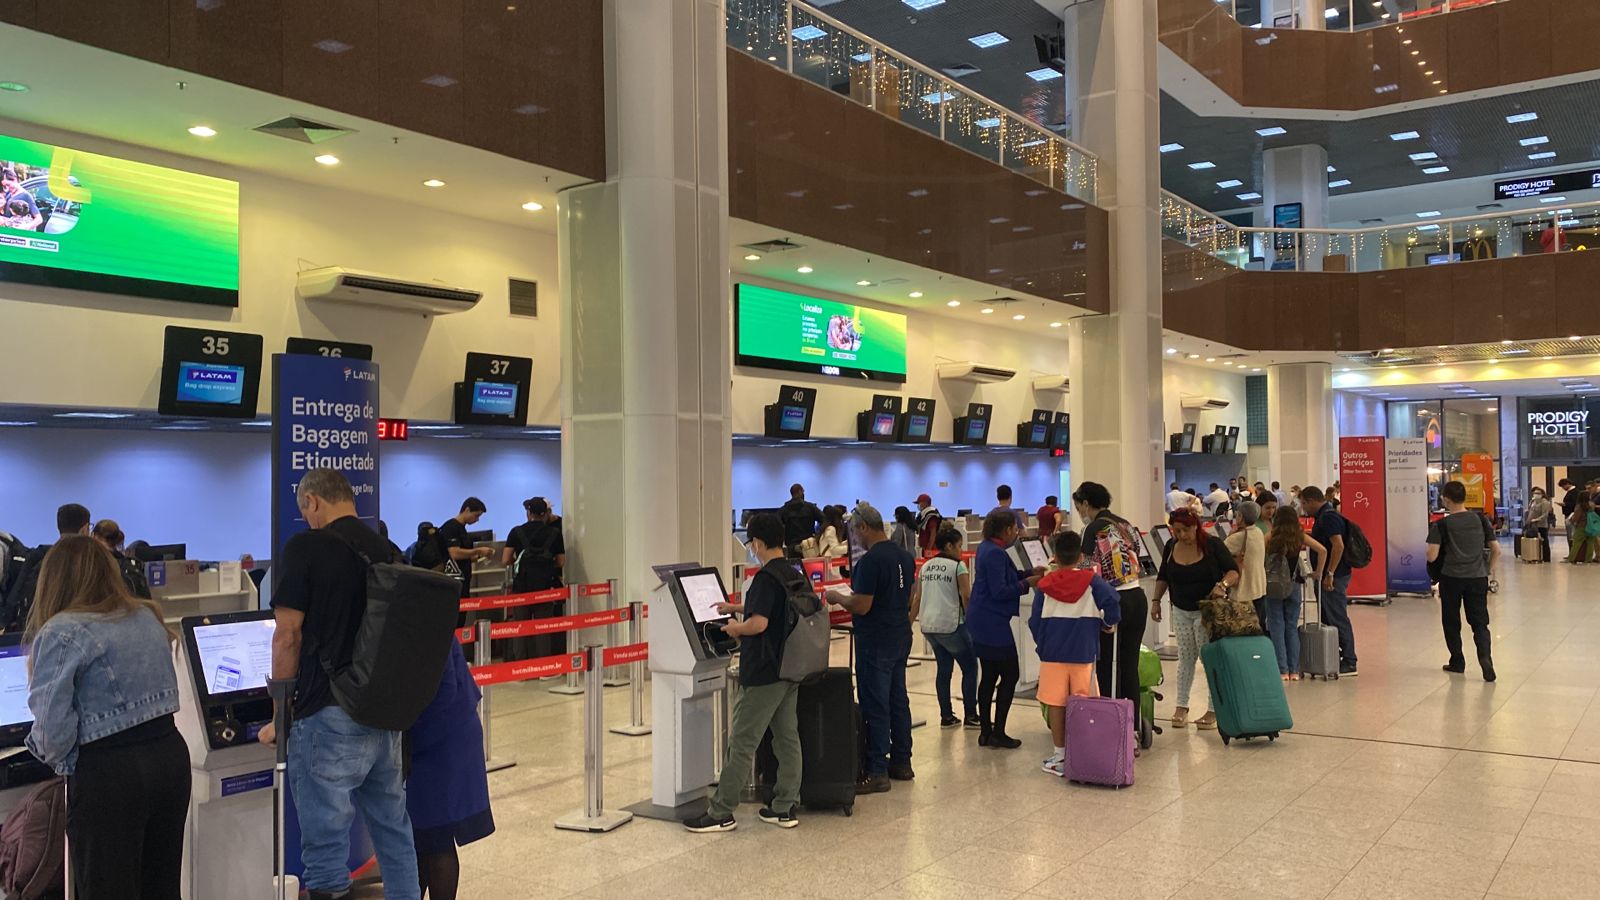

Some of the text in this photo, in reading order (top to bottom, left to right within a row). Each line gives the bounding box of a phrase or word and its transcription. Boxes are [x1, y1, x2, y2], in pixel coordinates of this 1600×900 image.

[1499, 180, 1556, 192] PRODIGY HOTEL
[202, 335, 229, 355] 35
[318, 347, 342, 357] 36
[490, 360, 510, 375] 37
[200, 372, 232, 380] LATAM
[353, 371, 376, 381] LATAM
[792, 391, 804, 402] 40
[883, 399, 893, 409] 41
[917, 402, 927, 412] 42
[292, 397, 374, 423] Entrega de
[976, 407, 985, 416] 43
[1528, 410, 1589, 424] PRODIGY
[1532, 423, 1586, 436] HOTEL
[292, 424, 368, 449] Bagagem
[292, 451, 374, 471] Etiquetada
[1342, 460, 1374, 468] Serviços
[363, 483, 374, 495] Drop
[185, 564, 195, 575] 35
[921, 574, 952, 583] CHECK-IN
[512, 662, 562, 676] hotmilhas.com.br
